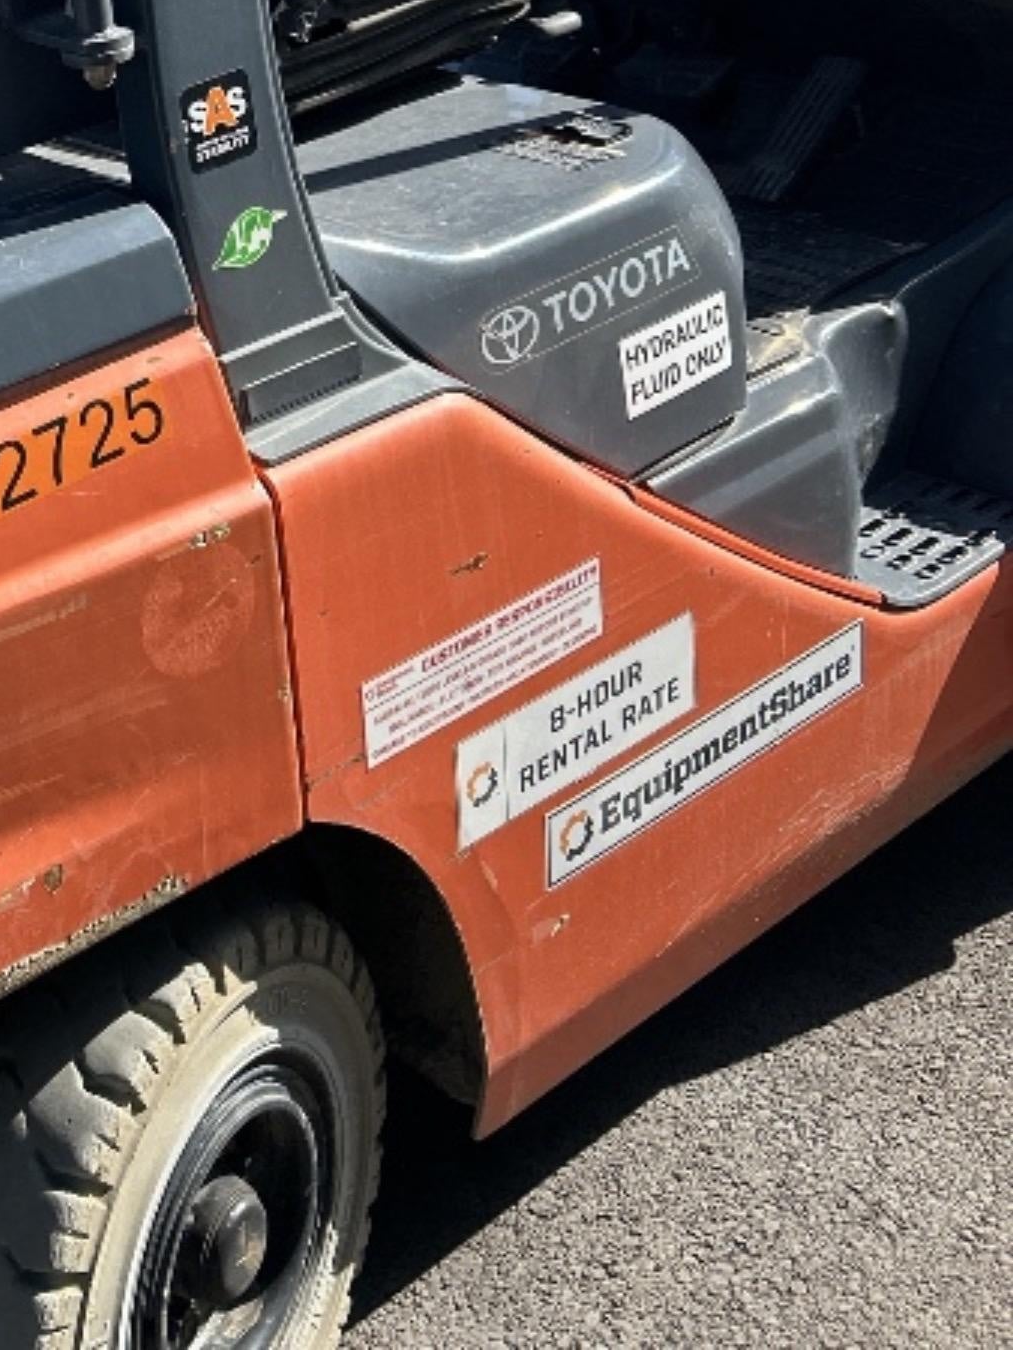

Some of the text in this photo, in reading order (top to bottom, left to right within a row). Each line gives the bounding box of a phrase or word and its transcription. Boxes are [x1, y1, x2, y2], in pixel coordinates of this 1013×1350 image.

[188, 86, 247, 136] SAS
[542, 237, 690, 334] TOYOTA
[625, 305, 724, 372] HYDRAULIC
[631, 336, 727, 406] FLUID ONLY
[421, 623, 492, 673] CUSTOMER
[550, 660, 643, 733] 8-HOUR
[519, 718, 613, 793] RENTAL
[622, 677, 681, 731] RATE
[600, 649, 852, 836] EquipmentShare
